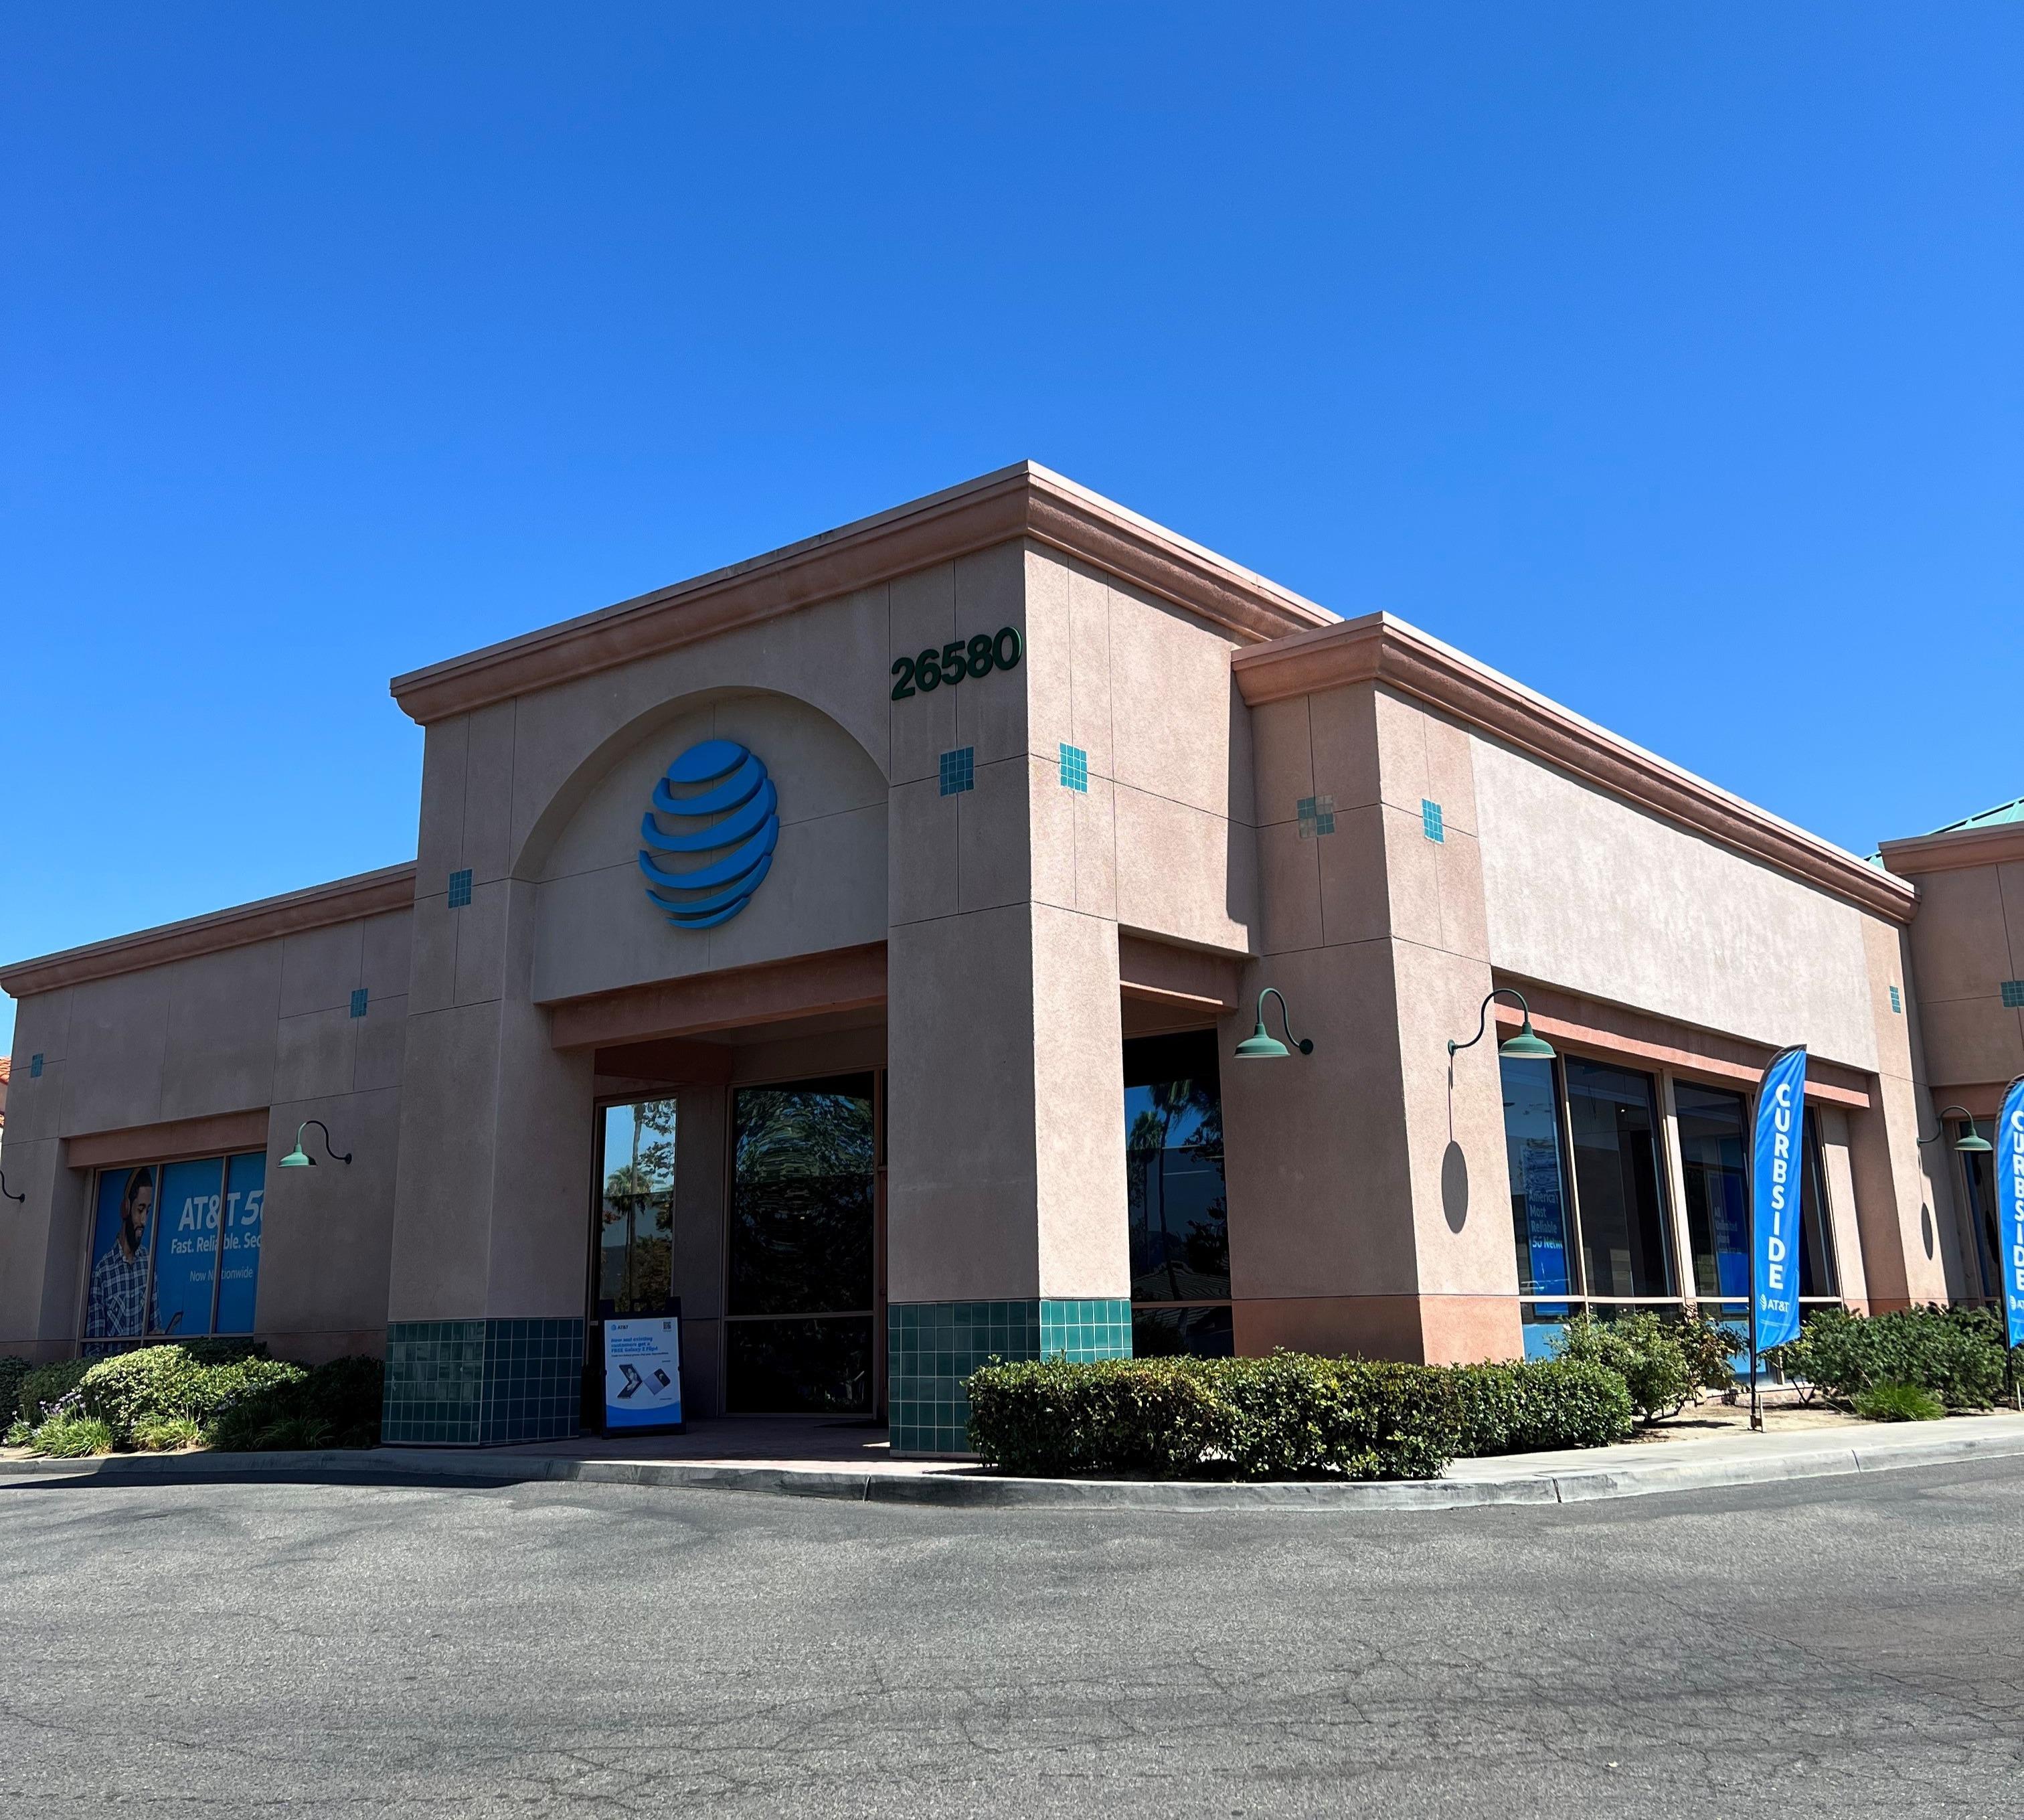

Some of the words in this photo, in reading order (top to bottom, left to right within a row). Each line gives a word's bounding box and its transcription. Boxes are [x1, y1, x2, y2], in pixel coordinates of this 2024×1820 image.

[892, 627, 1022, 701] 26580
[1768, 1084, 1790, 1290] CURBSIDE
[178, 1192, 241, 1232] AT&T
[241, 1190, 264, 1226] 5
[1529, 1205, 1547, 1218] Most
[1531, 1220, 1557, 1234] Reliable
[171, 1238, 193, 1254] Fast.
[1532, 1236, 1542, 1248] 5G
[190, 1270, 206, 1282] Now
[207, 1266, 253, 1281] Ntionwide
[1768, 1299, 1790, 1312] AT&T
